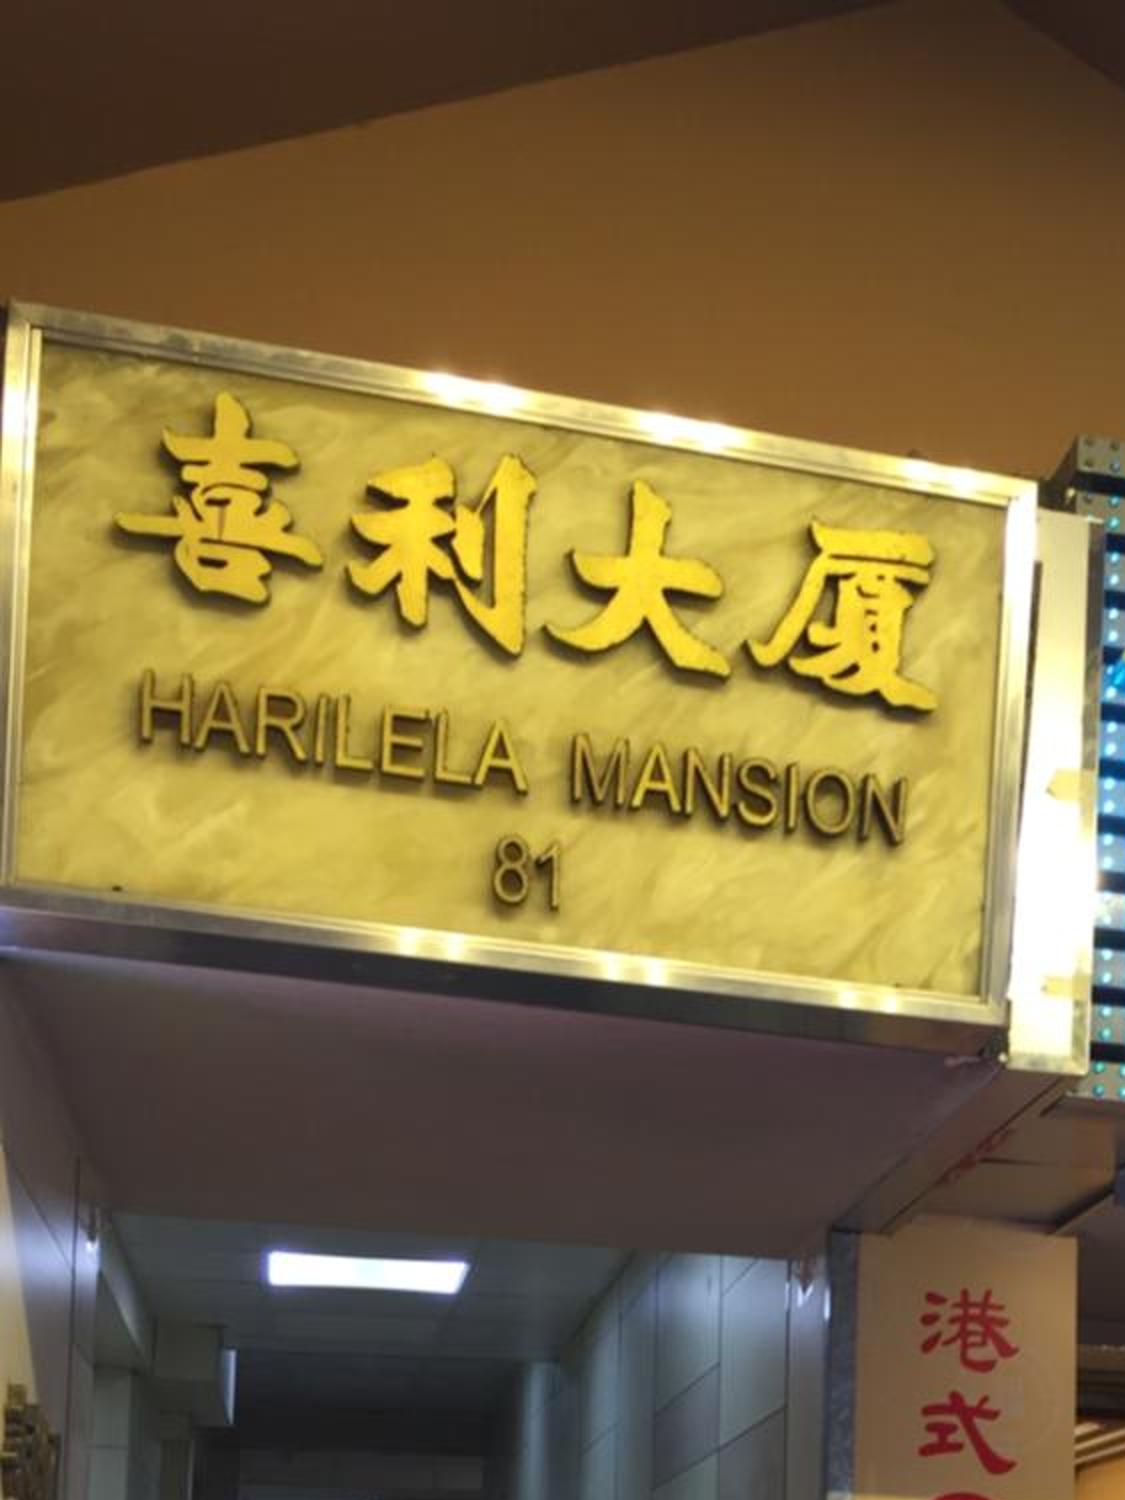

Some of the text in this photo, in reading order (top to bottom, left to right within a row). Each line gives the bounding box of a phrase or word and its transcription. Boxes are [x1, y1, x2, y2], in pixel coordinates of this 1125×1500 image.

[138, 668, 908, 847] HARILELA MANSION
[491, 834, 563, 912] 81
